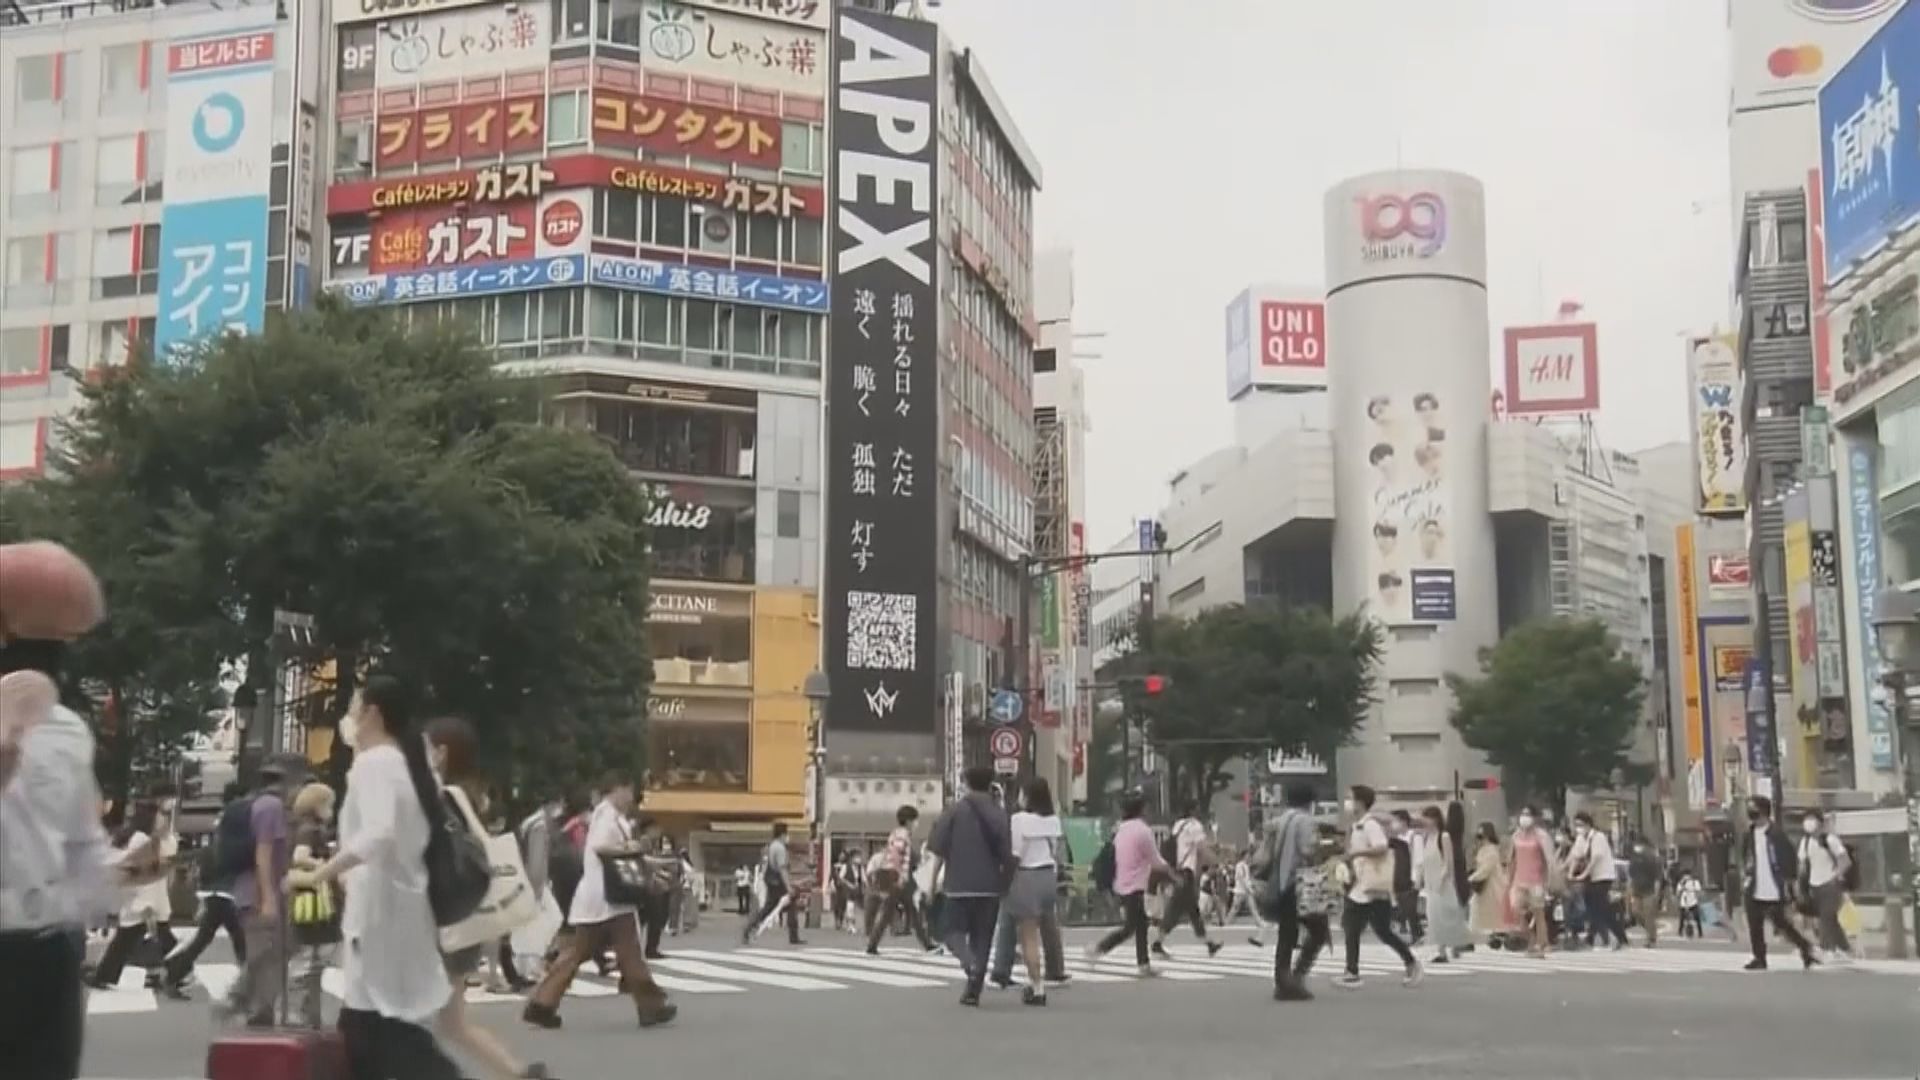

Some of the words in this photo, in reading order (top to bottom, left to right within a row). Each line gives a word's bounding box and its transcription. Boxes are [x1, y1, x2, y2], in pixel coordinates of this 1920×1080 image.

[179, 36, 266, 70] 当ビル5F
[343, 45, 374, 70] 9F
[707, 24, 816, 76] しゃぶ葉
[379, 102, 540, 156] プライス
[594, 97, 774, 156] コンタクト
[840, 14, 930, 286] APEX
[475, 162, 555, 201] ガスト
[723, 177, 805, 218] ガスト
[334, 234, 371, 264] 7F
[427, 214, 526, 265] ガスト
[602, 259, 652, 283] AEON
[853, 289, 876, 340] 遠く
[1267, 308, 1315, 334] UNI
[1268, 337, 1319, 362] QLO
[852, 442, 876, 496] 孤独
[892, 446, 914, 497] ただ
[851, 519, 875, 573] 灯す
